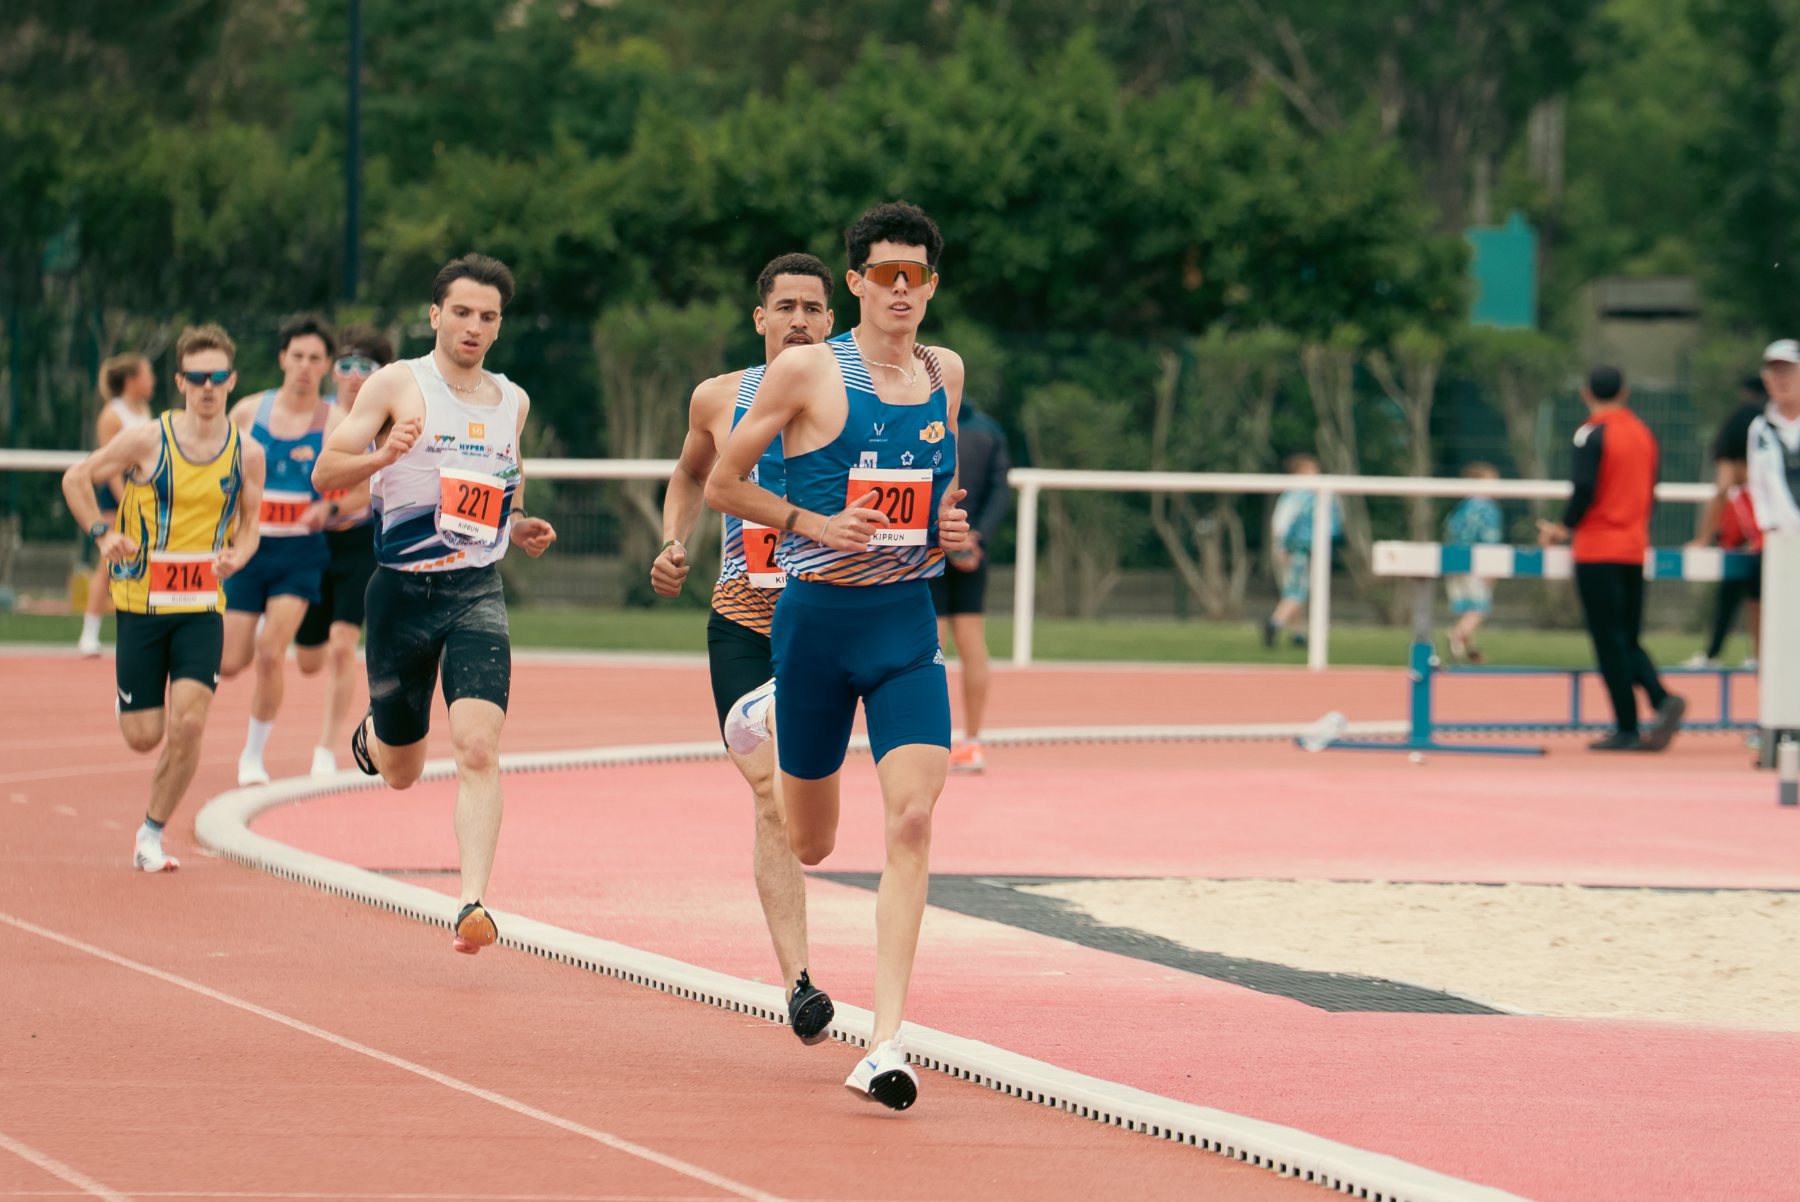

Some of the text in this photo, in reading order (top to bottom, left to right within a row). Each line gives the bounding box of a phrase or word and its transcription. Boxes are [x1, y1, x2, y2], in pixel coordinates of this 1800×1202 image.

[267, 502, 295, 523] 211
[457, 484, 490, 520] 221
[867, 486, 915, 524] 220
[458, 522, 480, 533] KIPRUN
[872, 533, 905, 541] KIPRUN
[166, 563, 203, 590] 214
